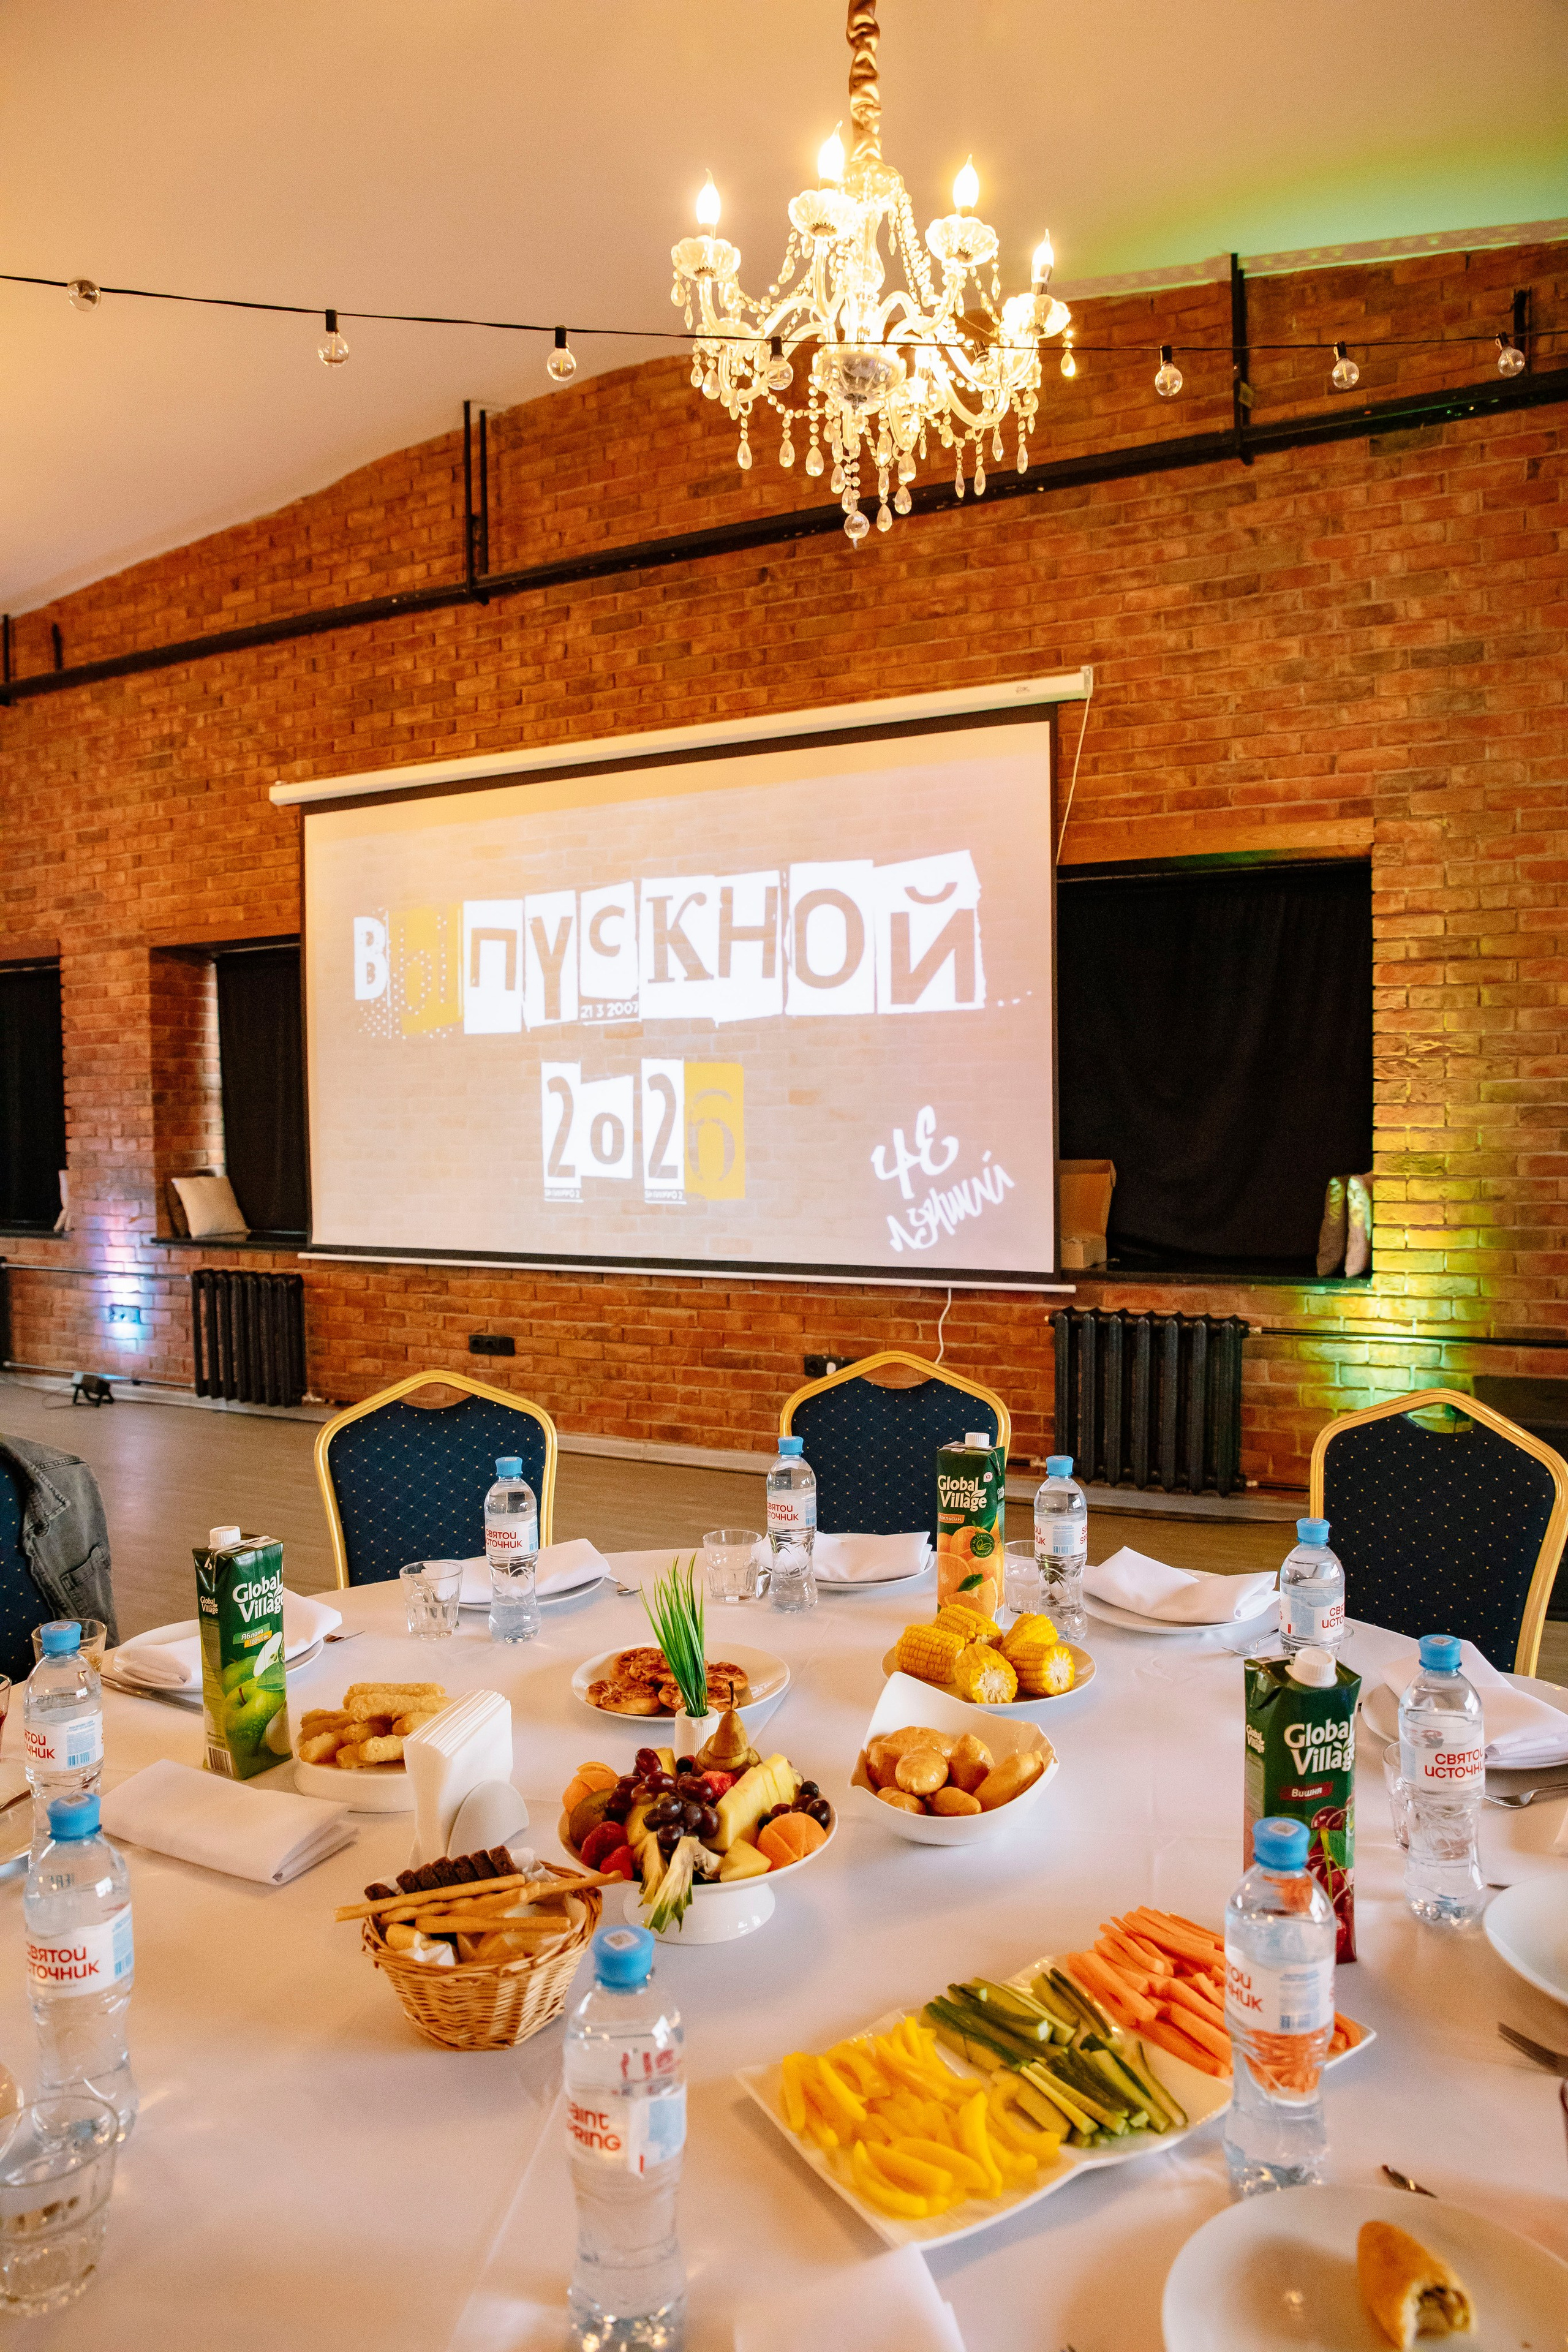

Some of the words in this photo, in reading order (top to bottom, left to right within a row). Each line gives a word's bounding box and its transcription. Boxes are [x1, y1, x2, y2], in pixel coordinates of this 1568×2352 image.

[546, 1073, 736, 1182] 2026
[938, 1475, 979, 1491] Global
[940, 1490, 987, 1512] Village
[486, 1537, 523, 1548] СТОЧНИК
[232, 1569, 281, 1604] Global
[200, 1596, 216, 1605] Global
[202, 1604, 219, 1615] Village
[241, 1629, 264, 1640] Яблоко
[1284, 1714, 1354, 1749] Global
[1291, 1787, 1322, 1797] Вишня
